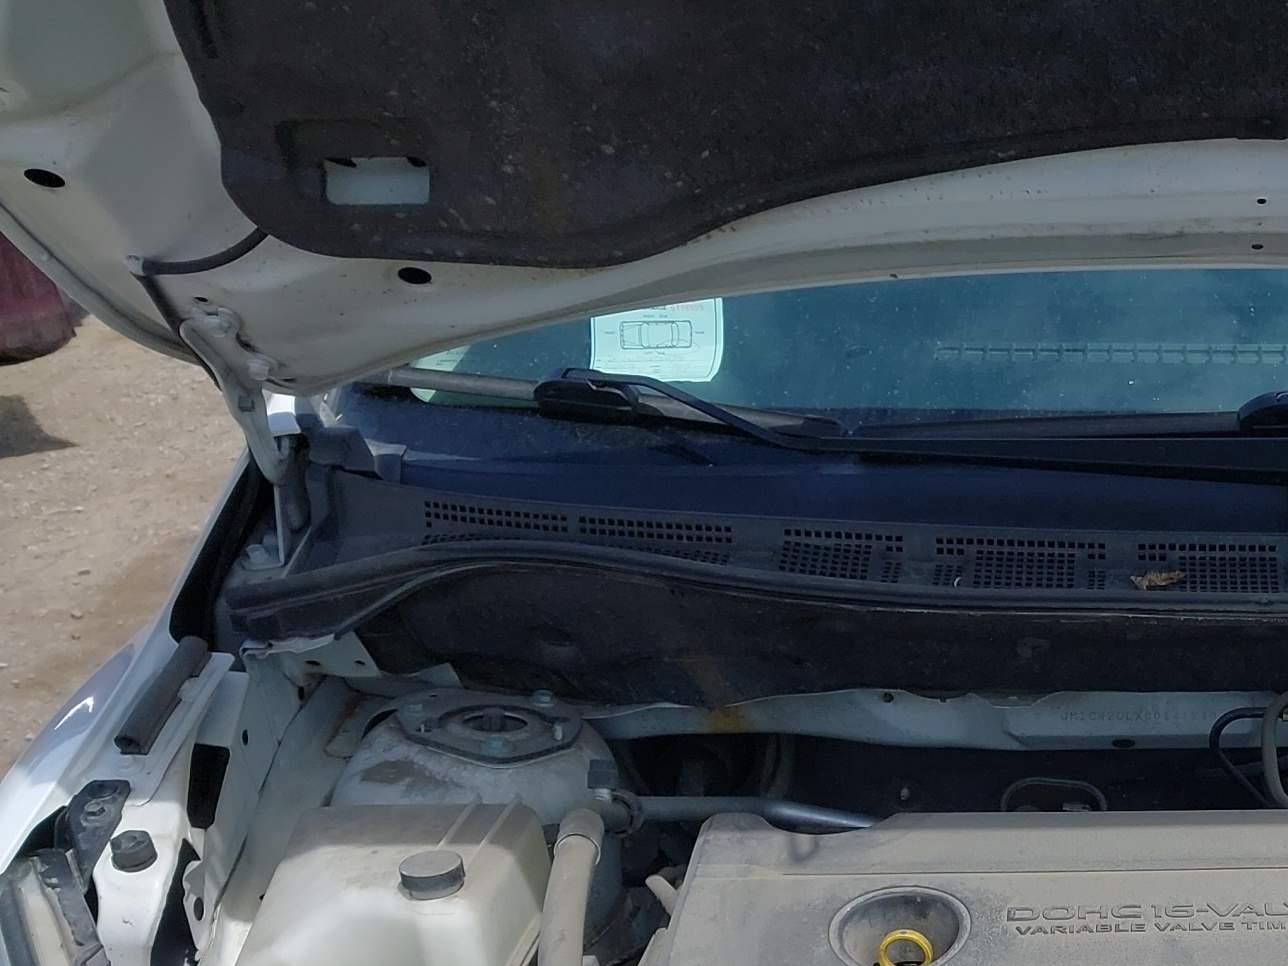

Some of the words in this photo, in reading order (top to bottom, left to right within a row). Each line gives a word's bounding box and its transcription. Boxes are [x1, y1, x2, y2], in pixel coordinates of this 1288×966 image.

[1006, 904, 1142, 922] DOHC
[1015, 922, 1147, 936] VARIABLE
[1154, 920, 1237, 932] VALVE
